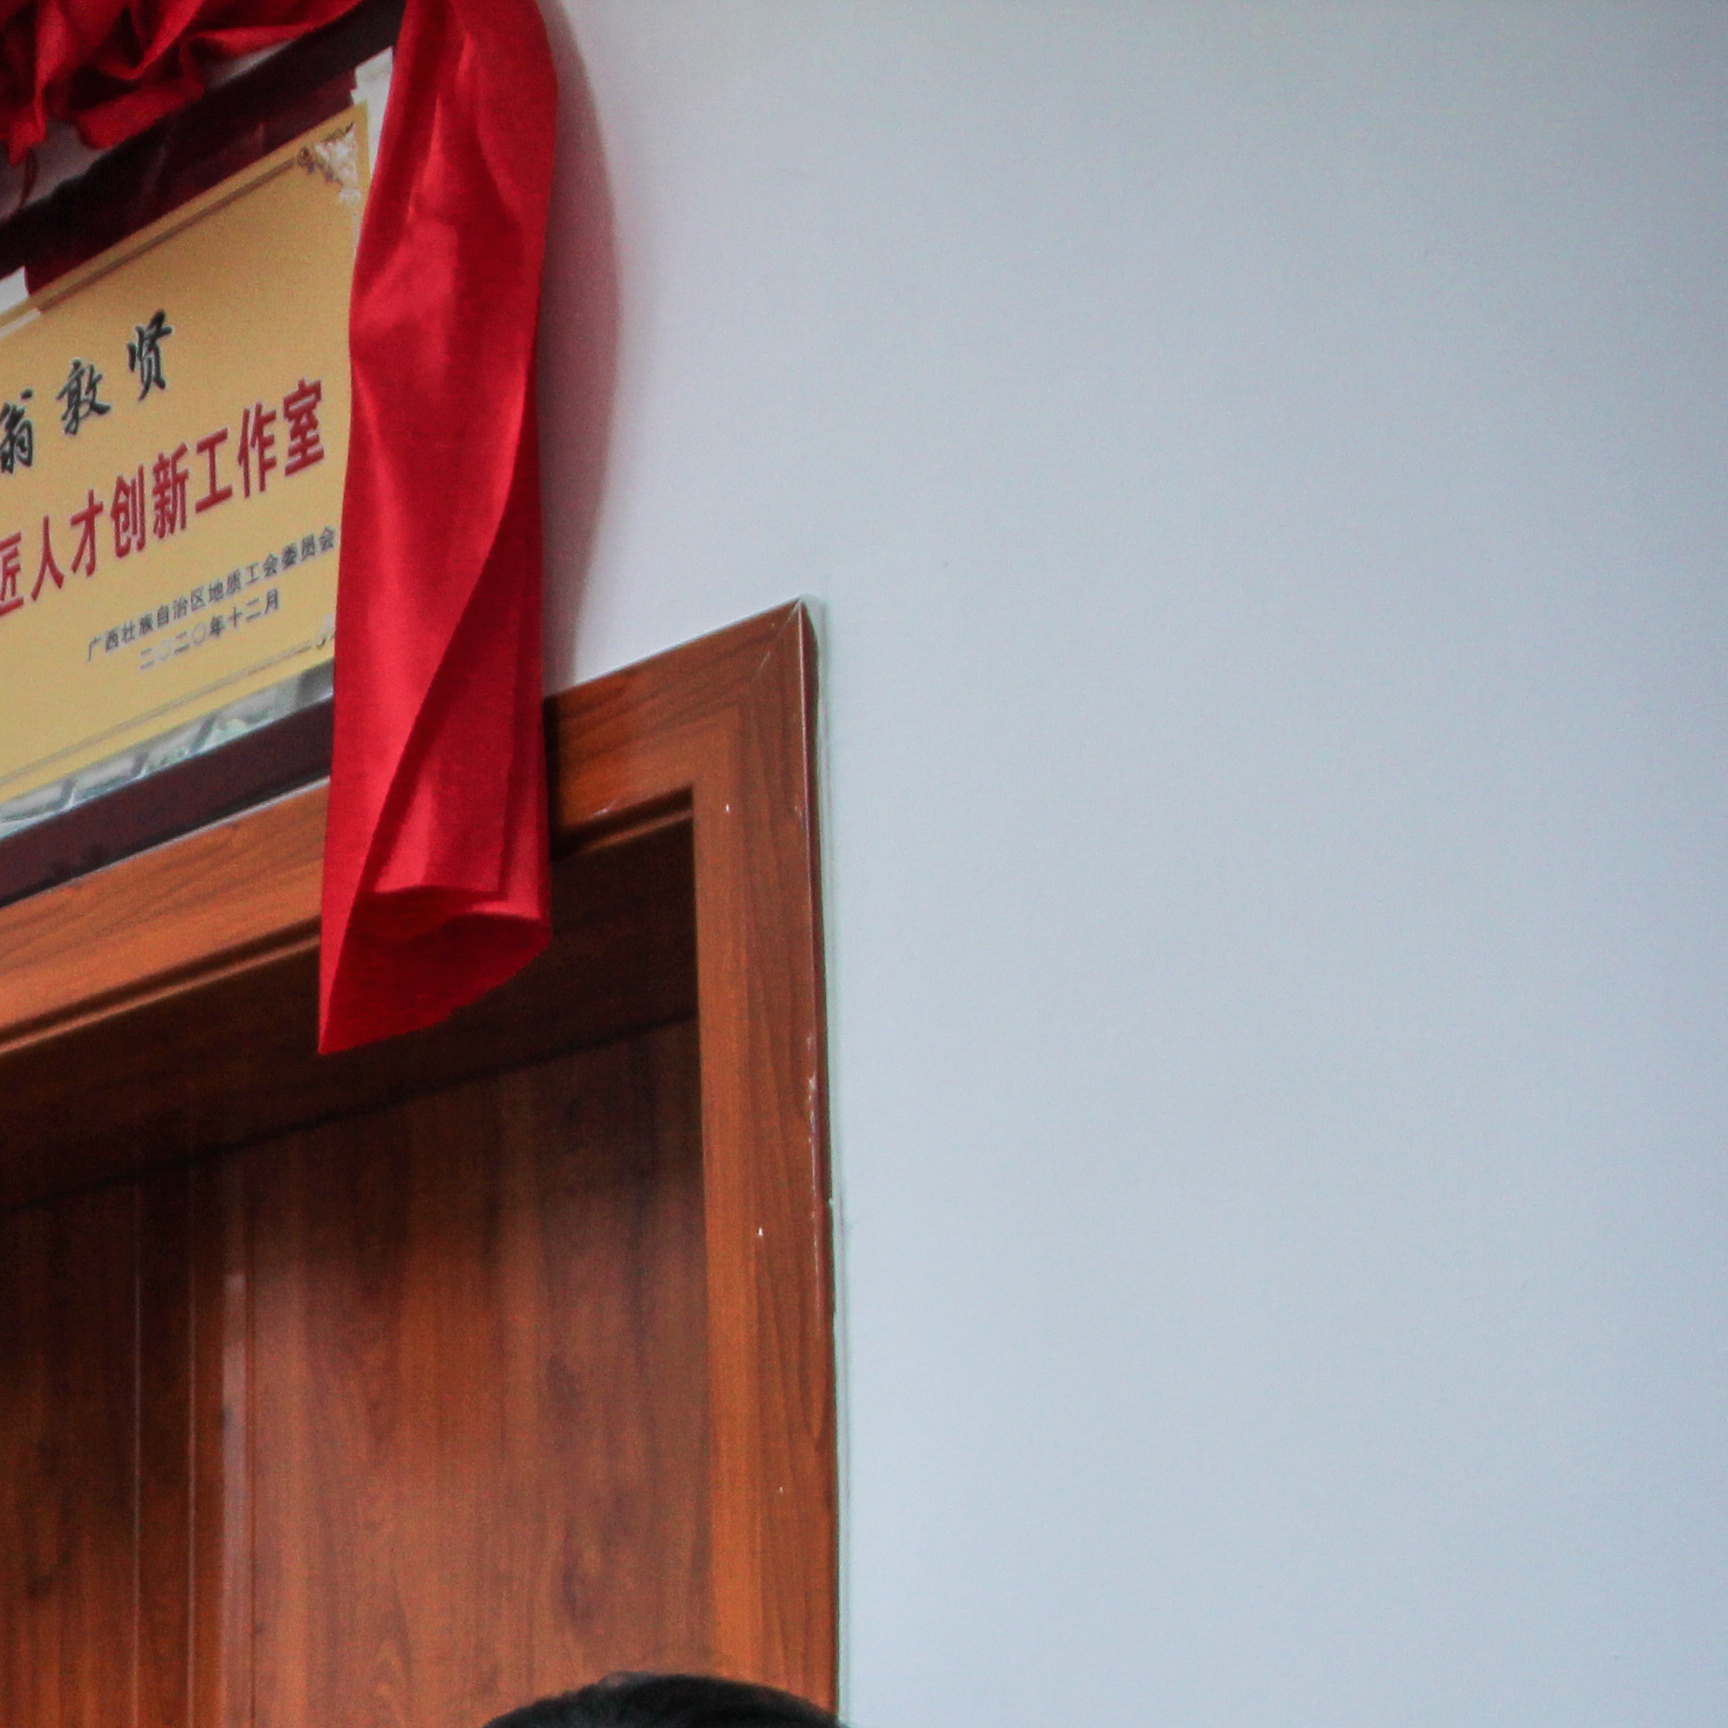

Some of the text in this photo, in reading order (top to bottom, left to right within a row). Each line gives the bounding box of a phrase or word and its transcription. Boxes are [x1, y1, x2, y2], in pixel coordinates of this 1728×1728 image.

[88, 526, 335, 661] 广西壮族自治区地质工会委员会
